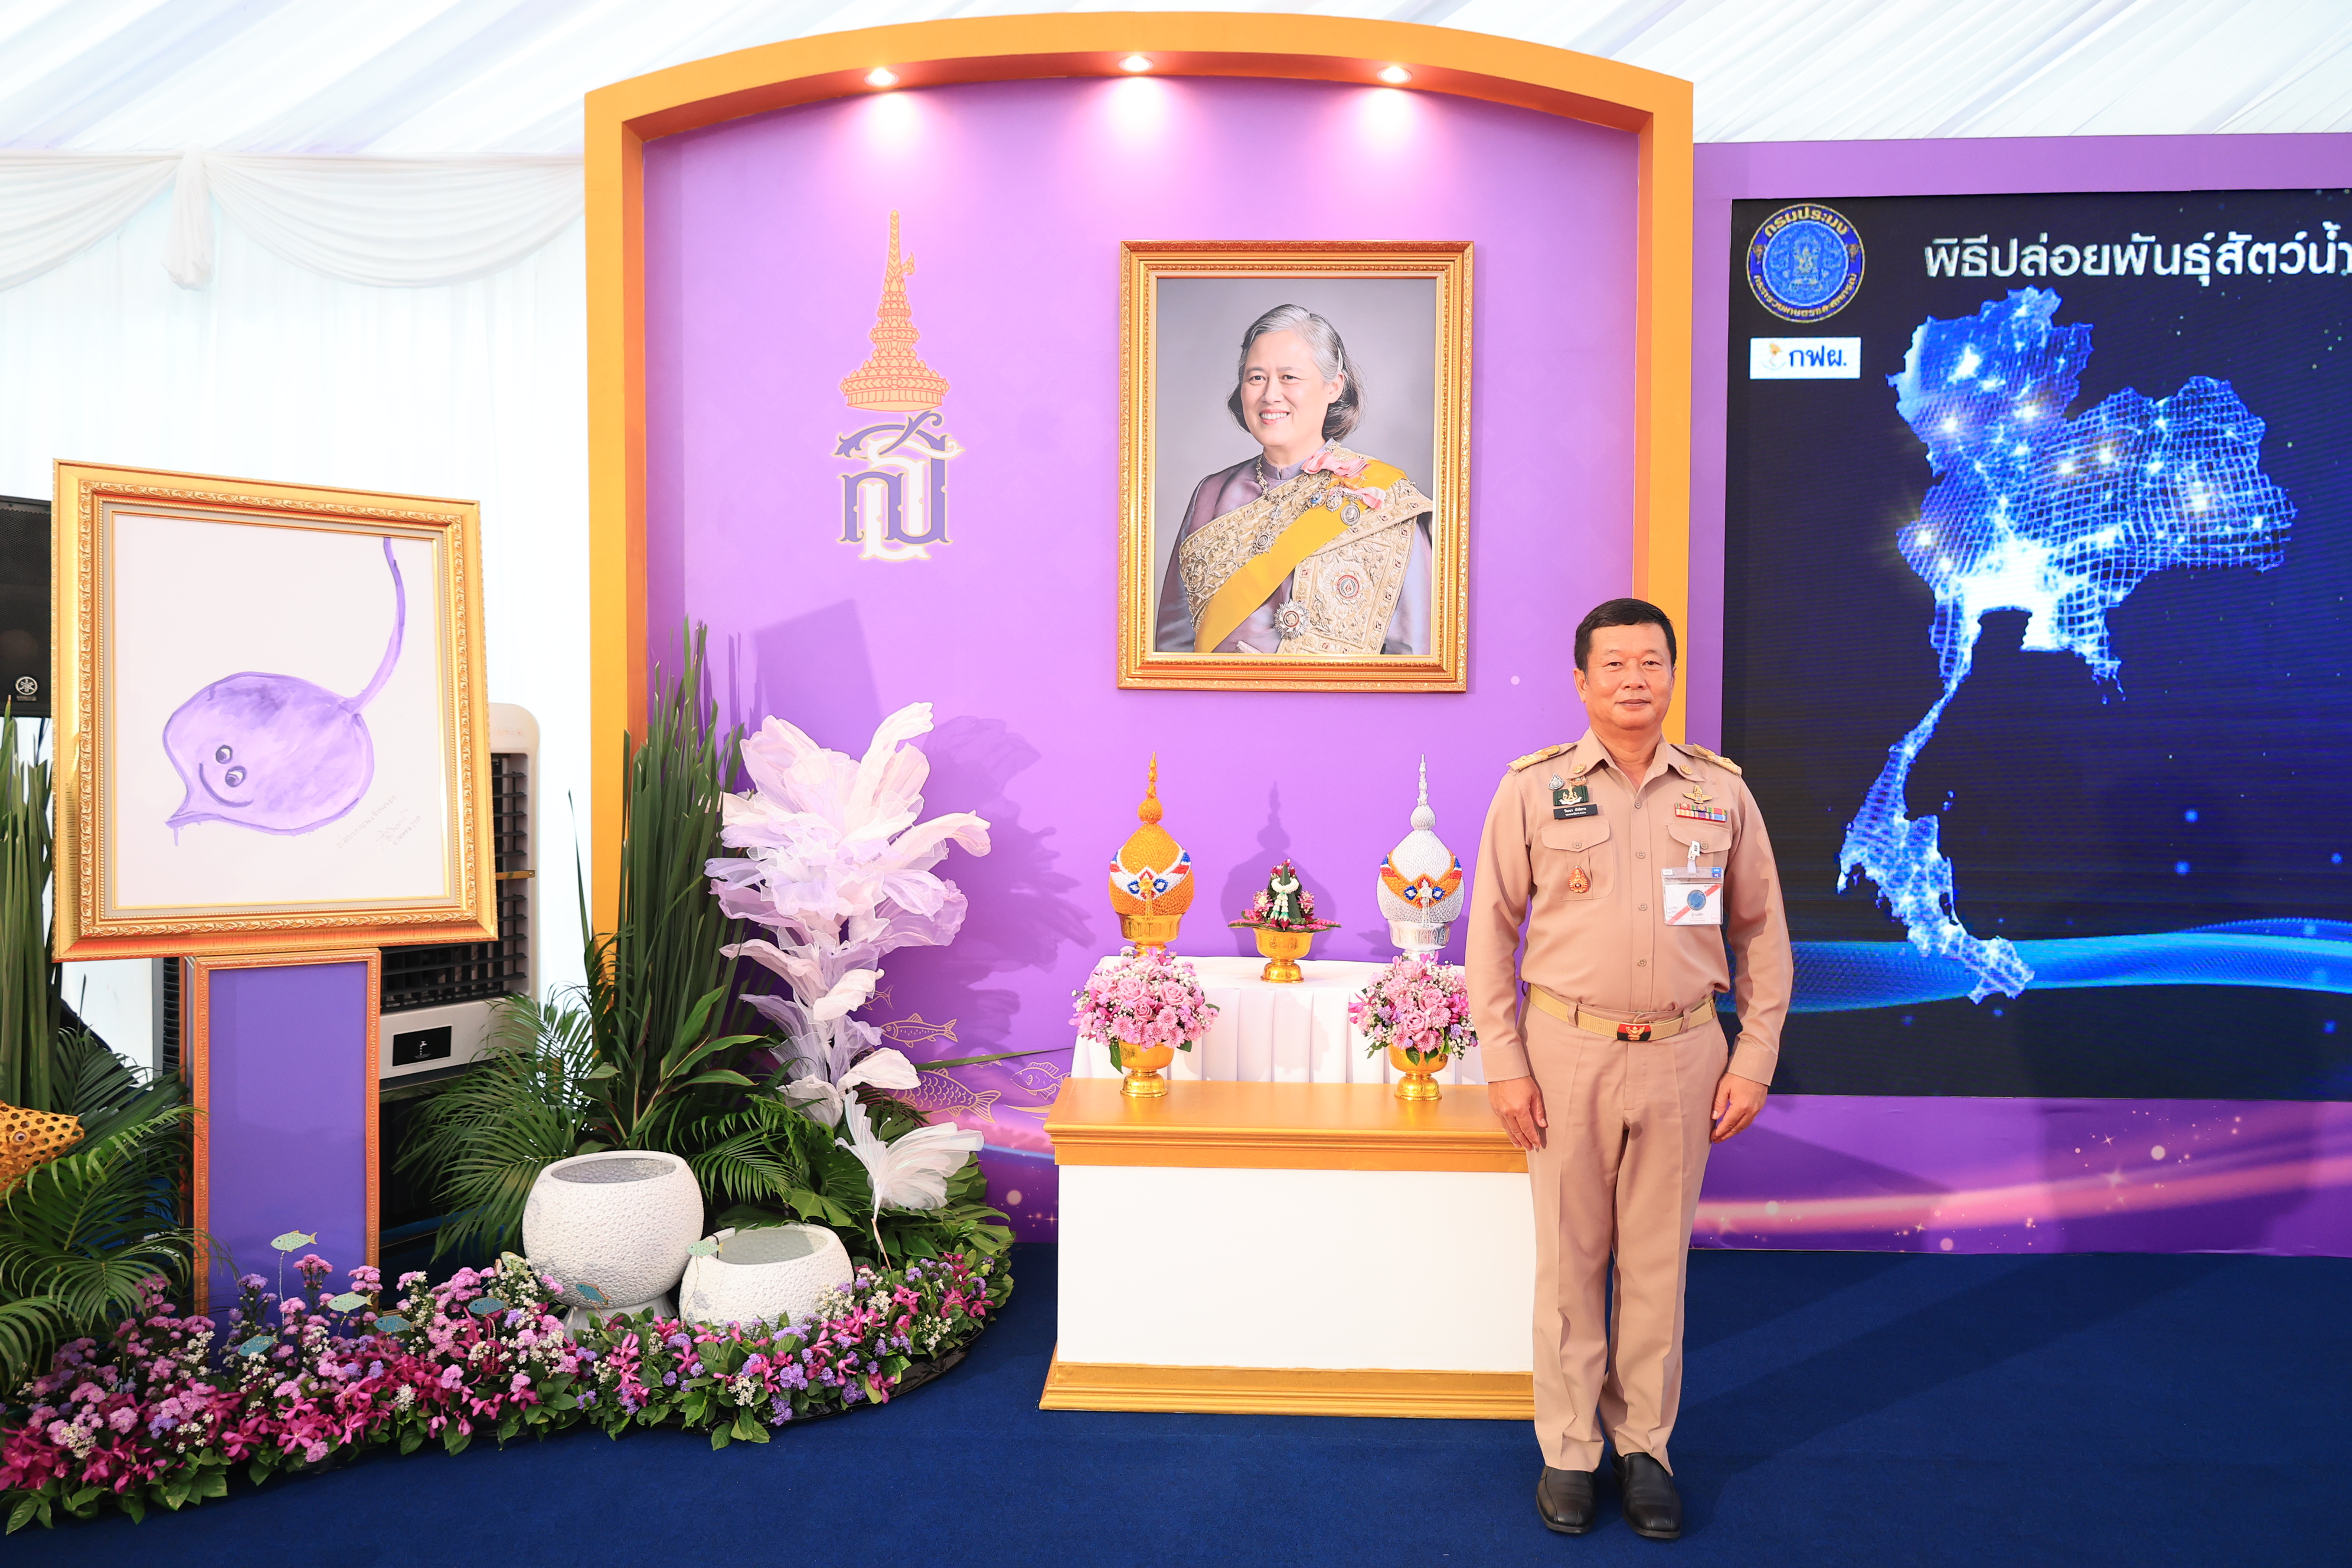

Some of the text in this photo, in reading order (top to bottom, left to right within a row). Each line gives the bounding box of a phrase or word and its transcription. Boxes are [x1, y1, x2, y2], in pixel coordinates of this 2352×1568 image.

[1763, 207, 1849, 238] กรมประมง
[1789, 345, 1847, 367] กฟผ.
